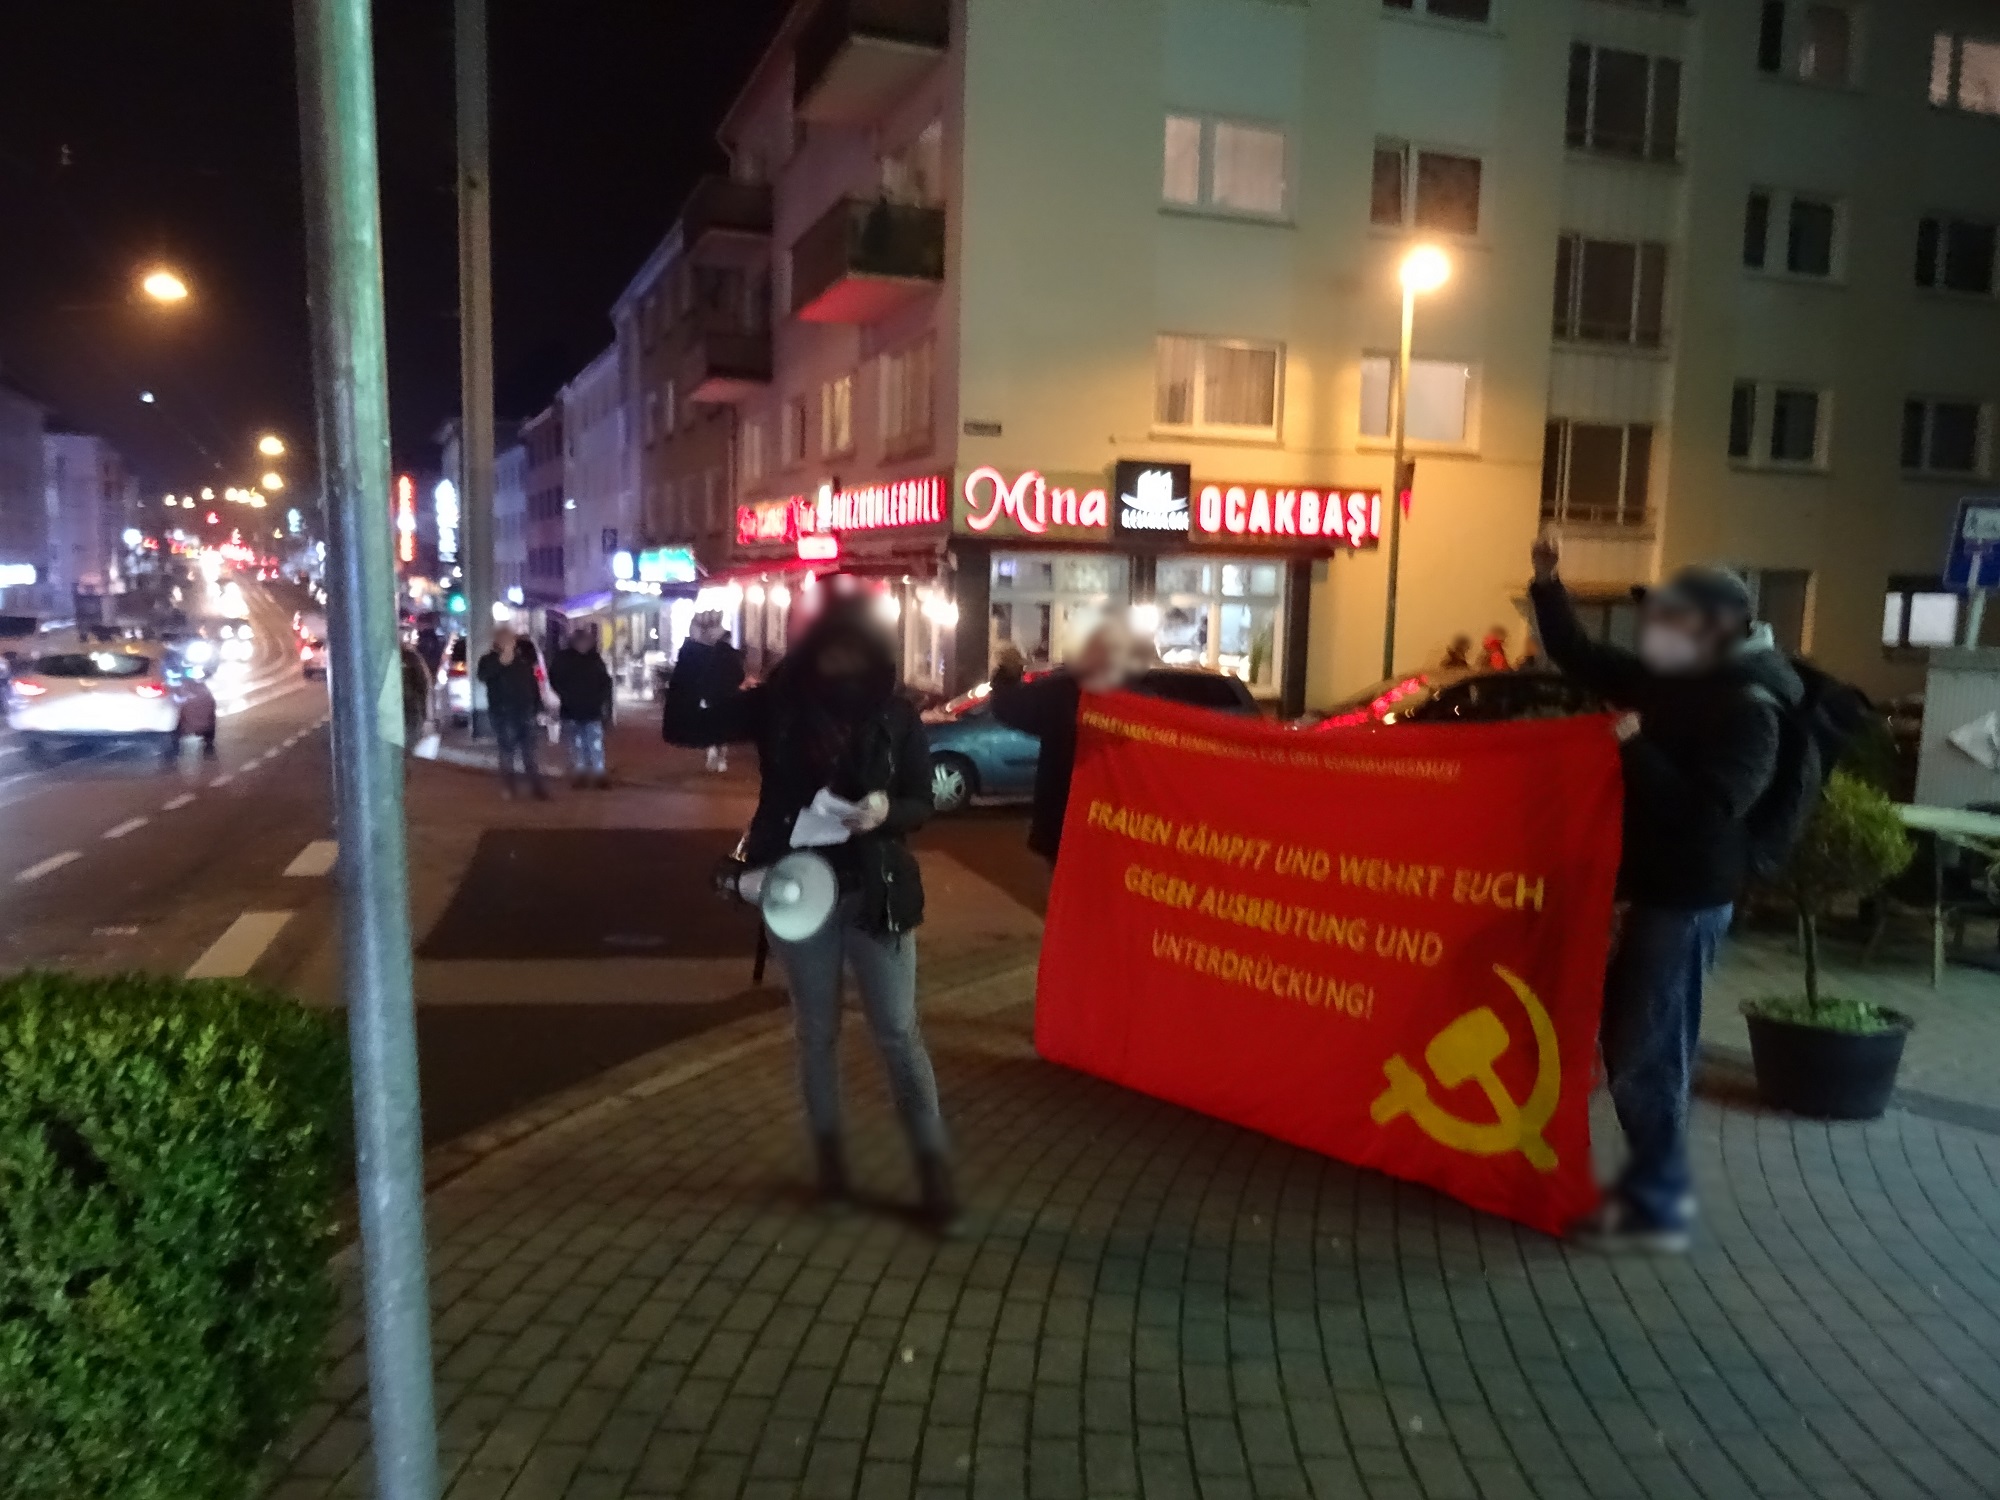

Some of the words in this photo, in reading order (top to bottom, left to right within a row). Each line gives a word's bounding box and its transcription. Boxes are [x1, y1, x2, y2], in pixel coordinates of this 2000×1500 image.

[965, 464, 1108, 535] Mina
[1197, 484, 1382, 548] OCAKBAŞI
[1087, 799, 1173, 846] FRAUEN
[1175, 822, 1272, 871] KÄMPFT
[1274, 844, 1332, 882] UND
[1339, 852, 1446, 898] WEHRT
[1452, 866, 1546, 912] EUCH
[1124, 864, 1197, 909] GEGEN
[1197, 886, 1368, 953] AUSBEUTUNG
[1375, 924, 1444, 968] UND
[1151, 928, 1375, 1021] UNTERDRÜCKUNG!
